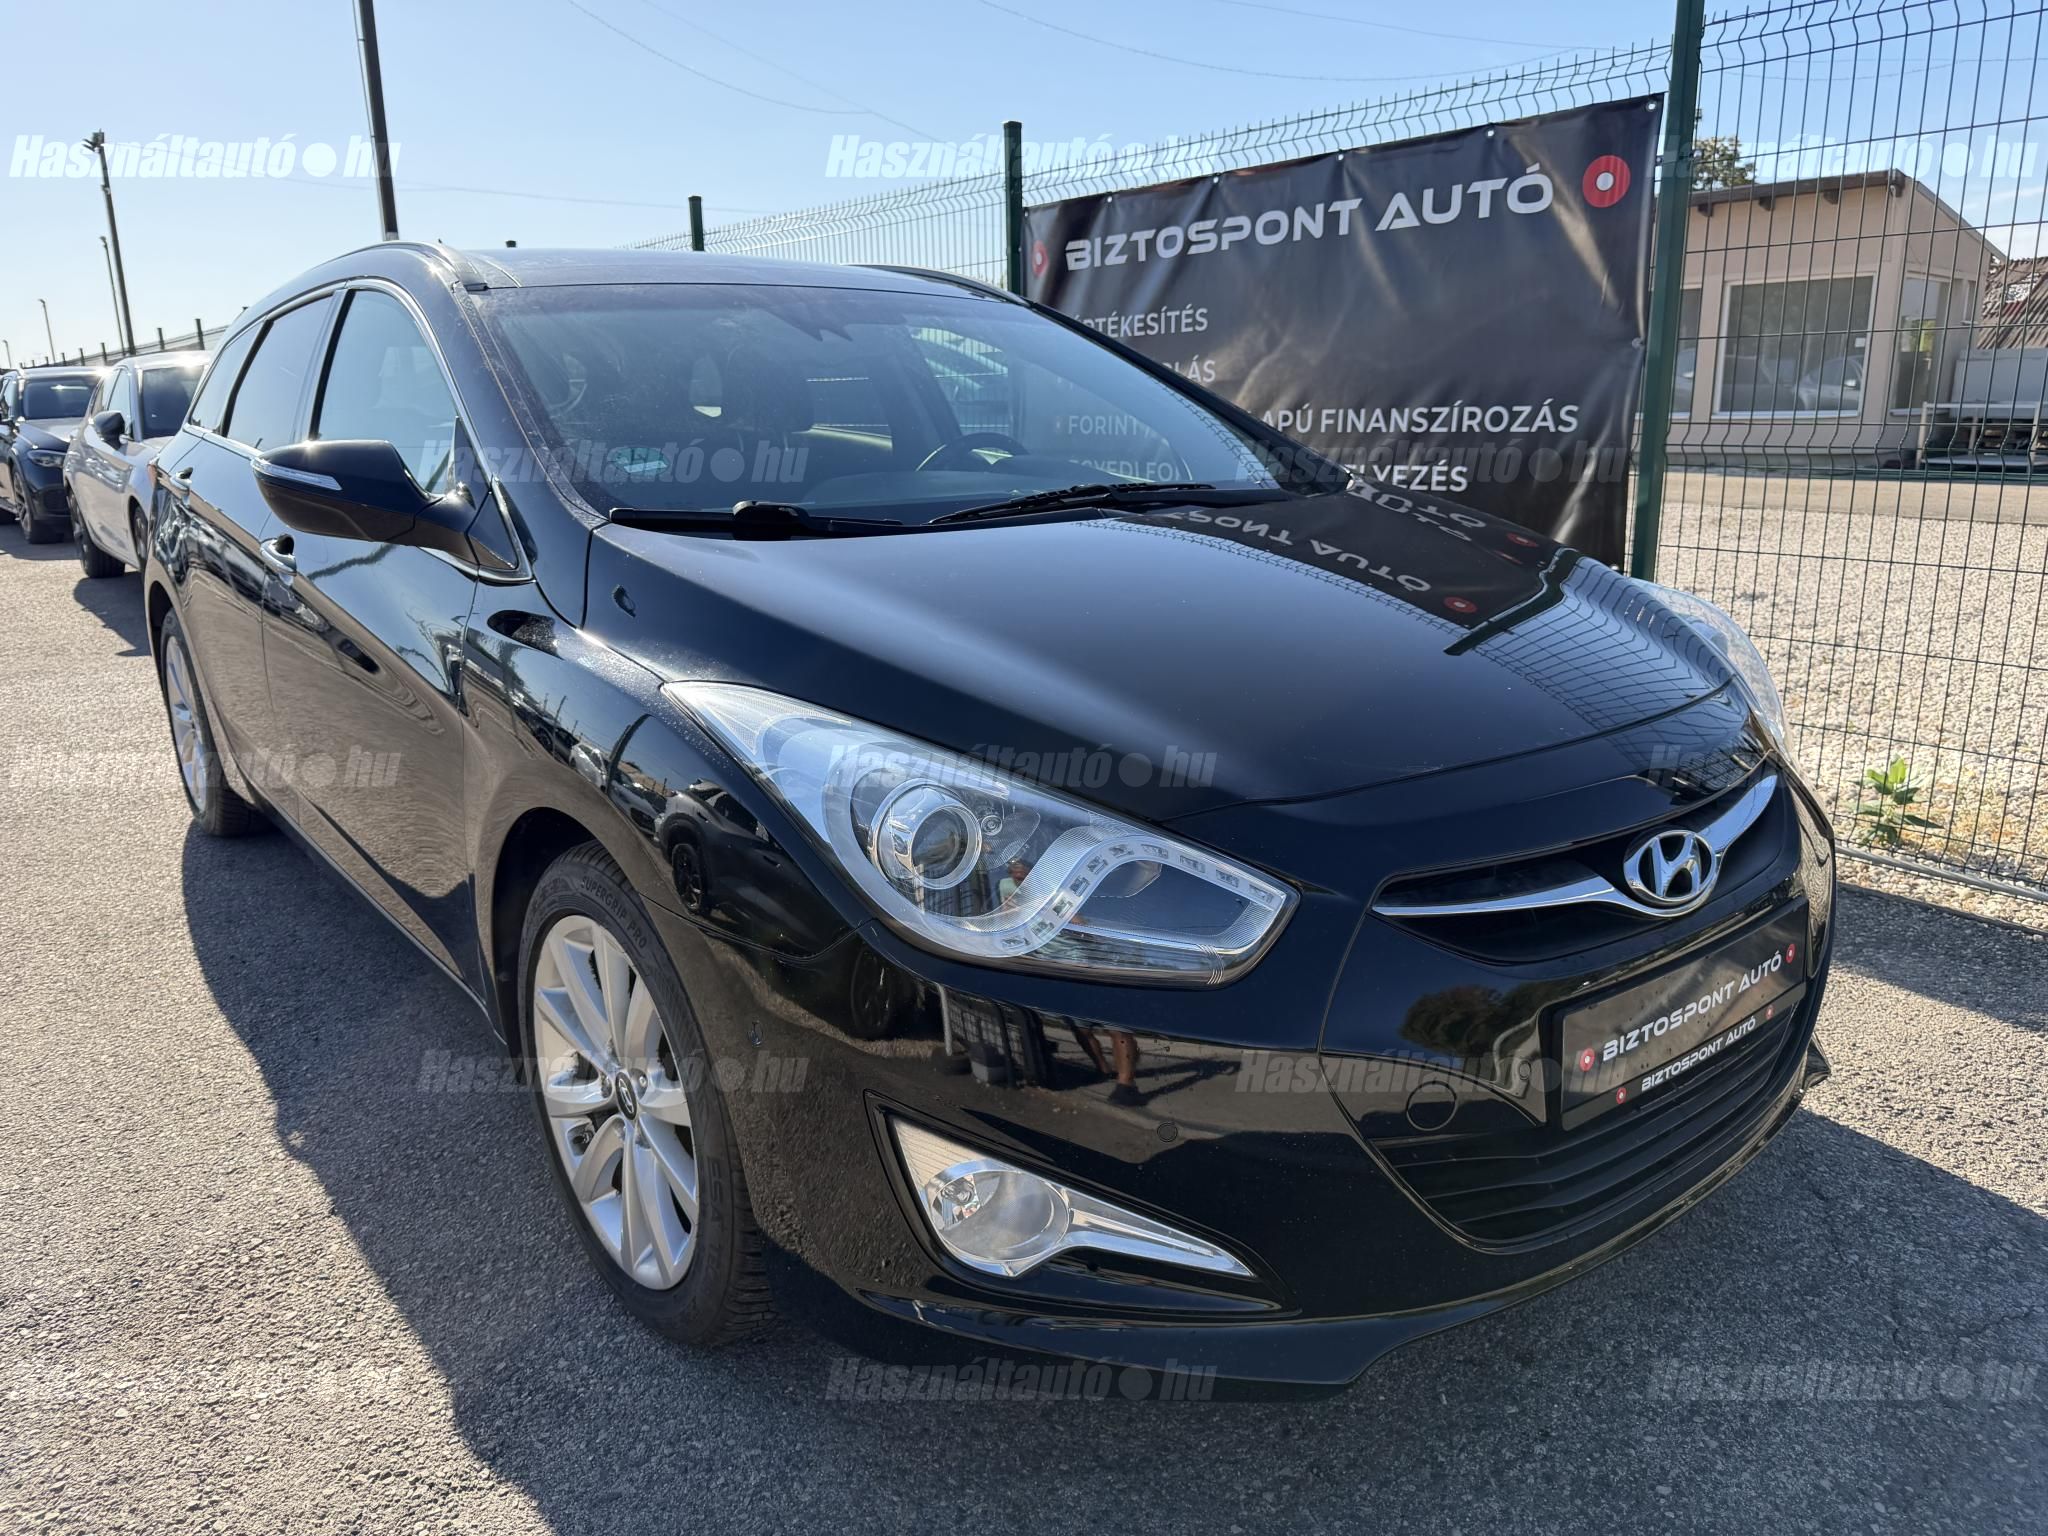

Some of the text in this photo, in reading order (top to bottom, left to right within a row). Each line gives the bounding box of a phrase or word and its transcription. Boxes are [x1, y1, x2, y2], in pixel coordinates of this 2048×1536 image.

[1065, 163, 1555, 271] BIZTOSPONT AUTÓ
[1074, 304, 1208, 338] TÉKESÍTÉS
[1068, 415, 1136, 436] FORINT
[1320, 398, 1578, 434] FINANSZÍROZÁS
[1602, 950, 1782, 1062] BIZTOSPONT AUTÓ
[1641, 1016, 1756, 1092] BIZTOSPONT AUTÓ
